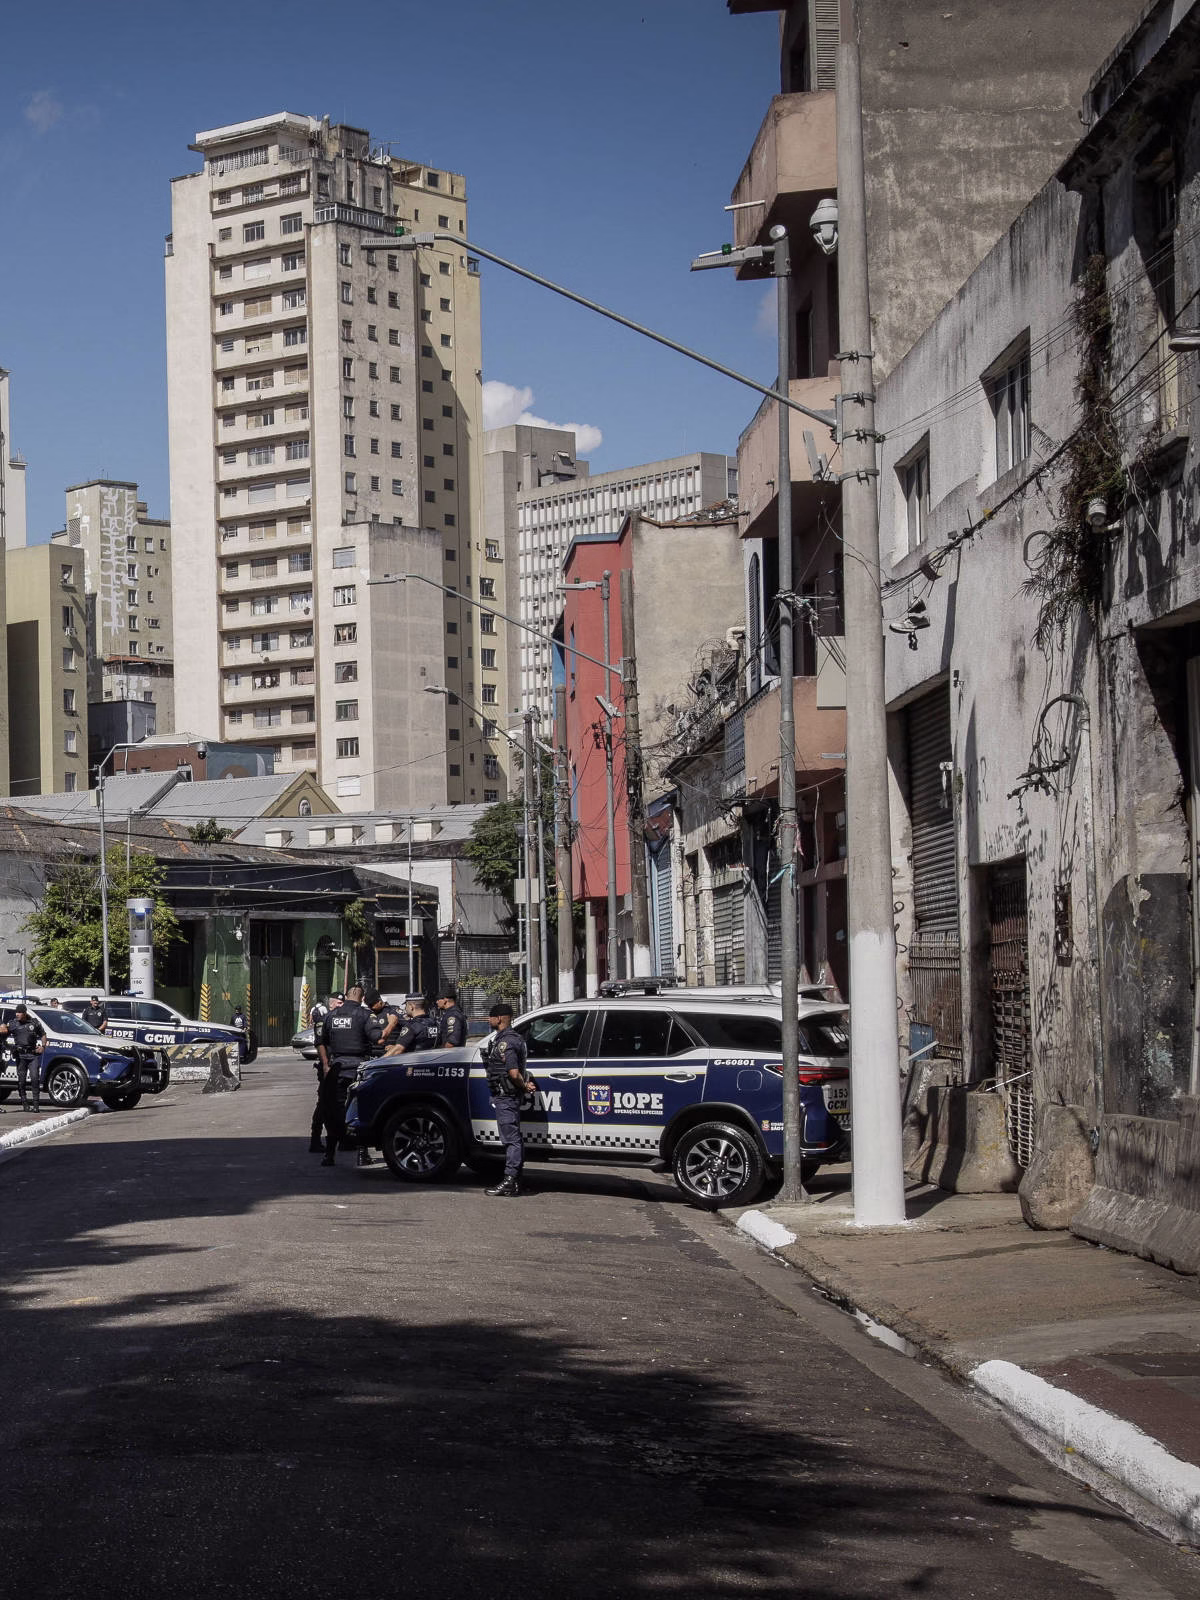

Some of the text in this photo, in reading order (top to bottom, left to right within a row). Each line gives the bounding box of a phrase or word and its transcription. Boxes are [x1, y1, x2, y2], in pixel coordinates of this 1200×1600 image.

[113, 1030, 134, 1038] IOPE
[145, 1034, 176, 1044] GCM
[444, 1067, 465, 1078] 153
[833, 1088, 849, 1099] 153
[519, 1091, 563, 1112] CM
[613, 1092, 663, 1110] IOPE
[828, 1100, 848, 1110] GCM
